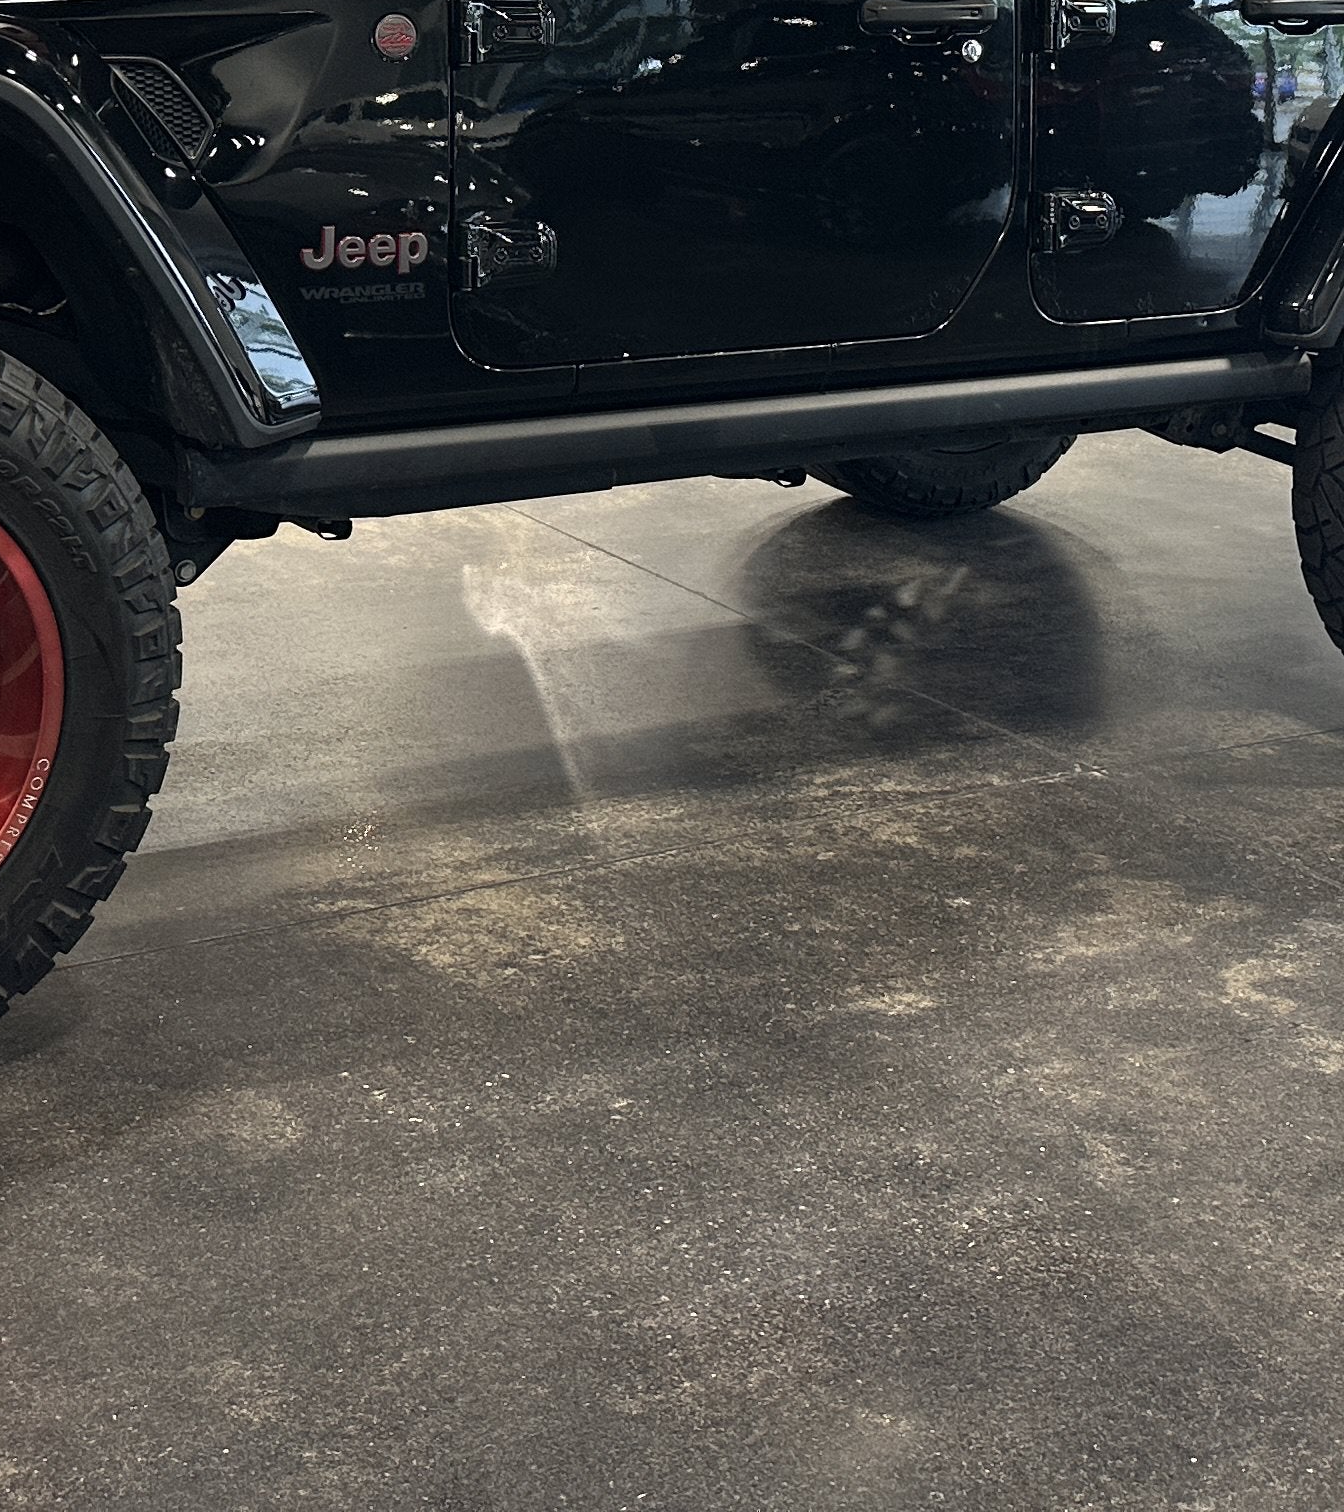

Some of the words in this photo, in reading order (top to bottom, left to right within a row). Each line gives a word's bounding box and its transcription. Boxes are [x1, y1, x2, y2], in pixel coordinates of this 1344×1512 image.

[299, 224, 429, 276] Jeep
[299, 282, 425, 301] WRANGLER
[338, 292, 425, 304] UNLIMITED
